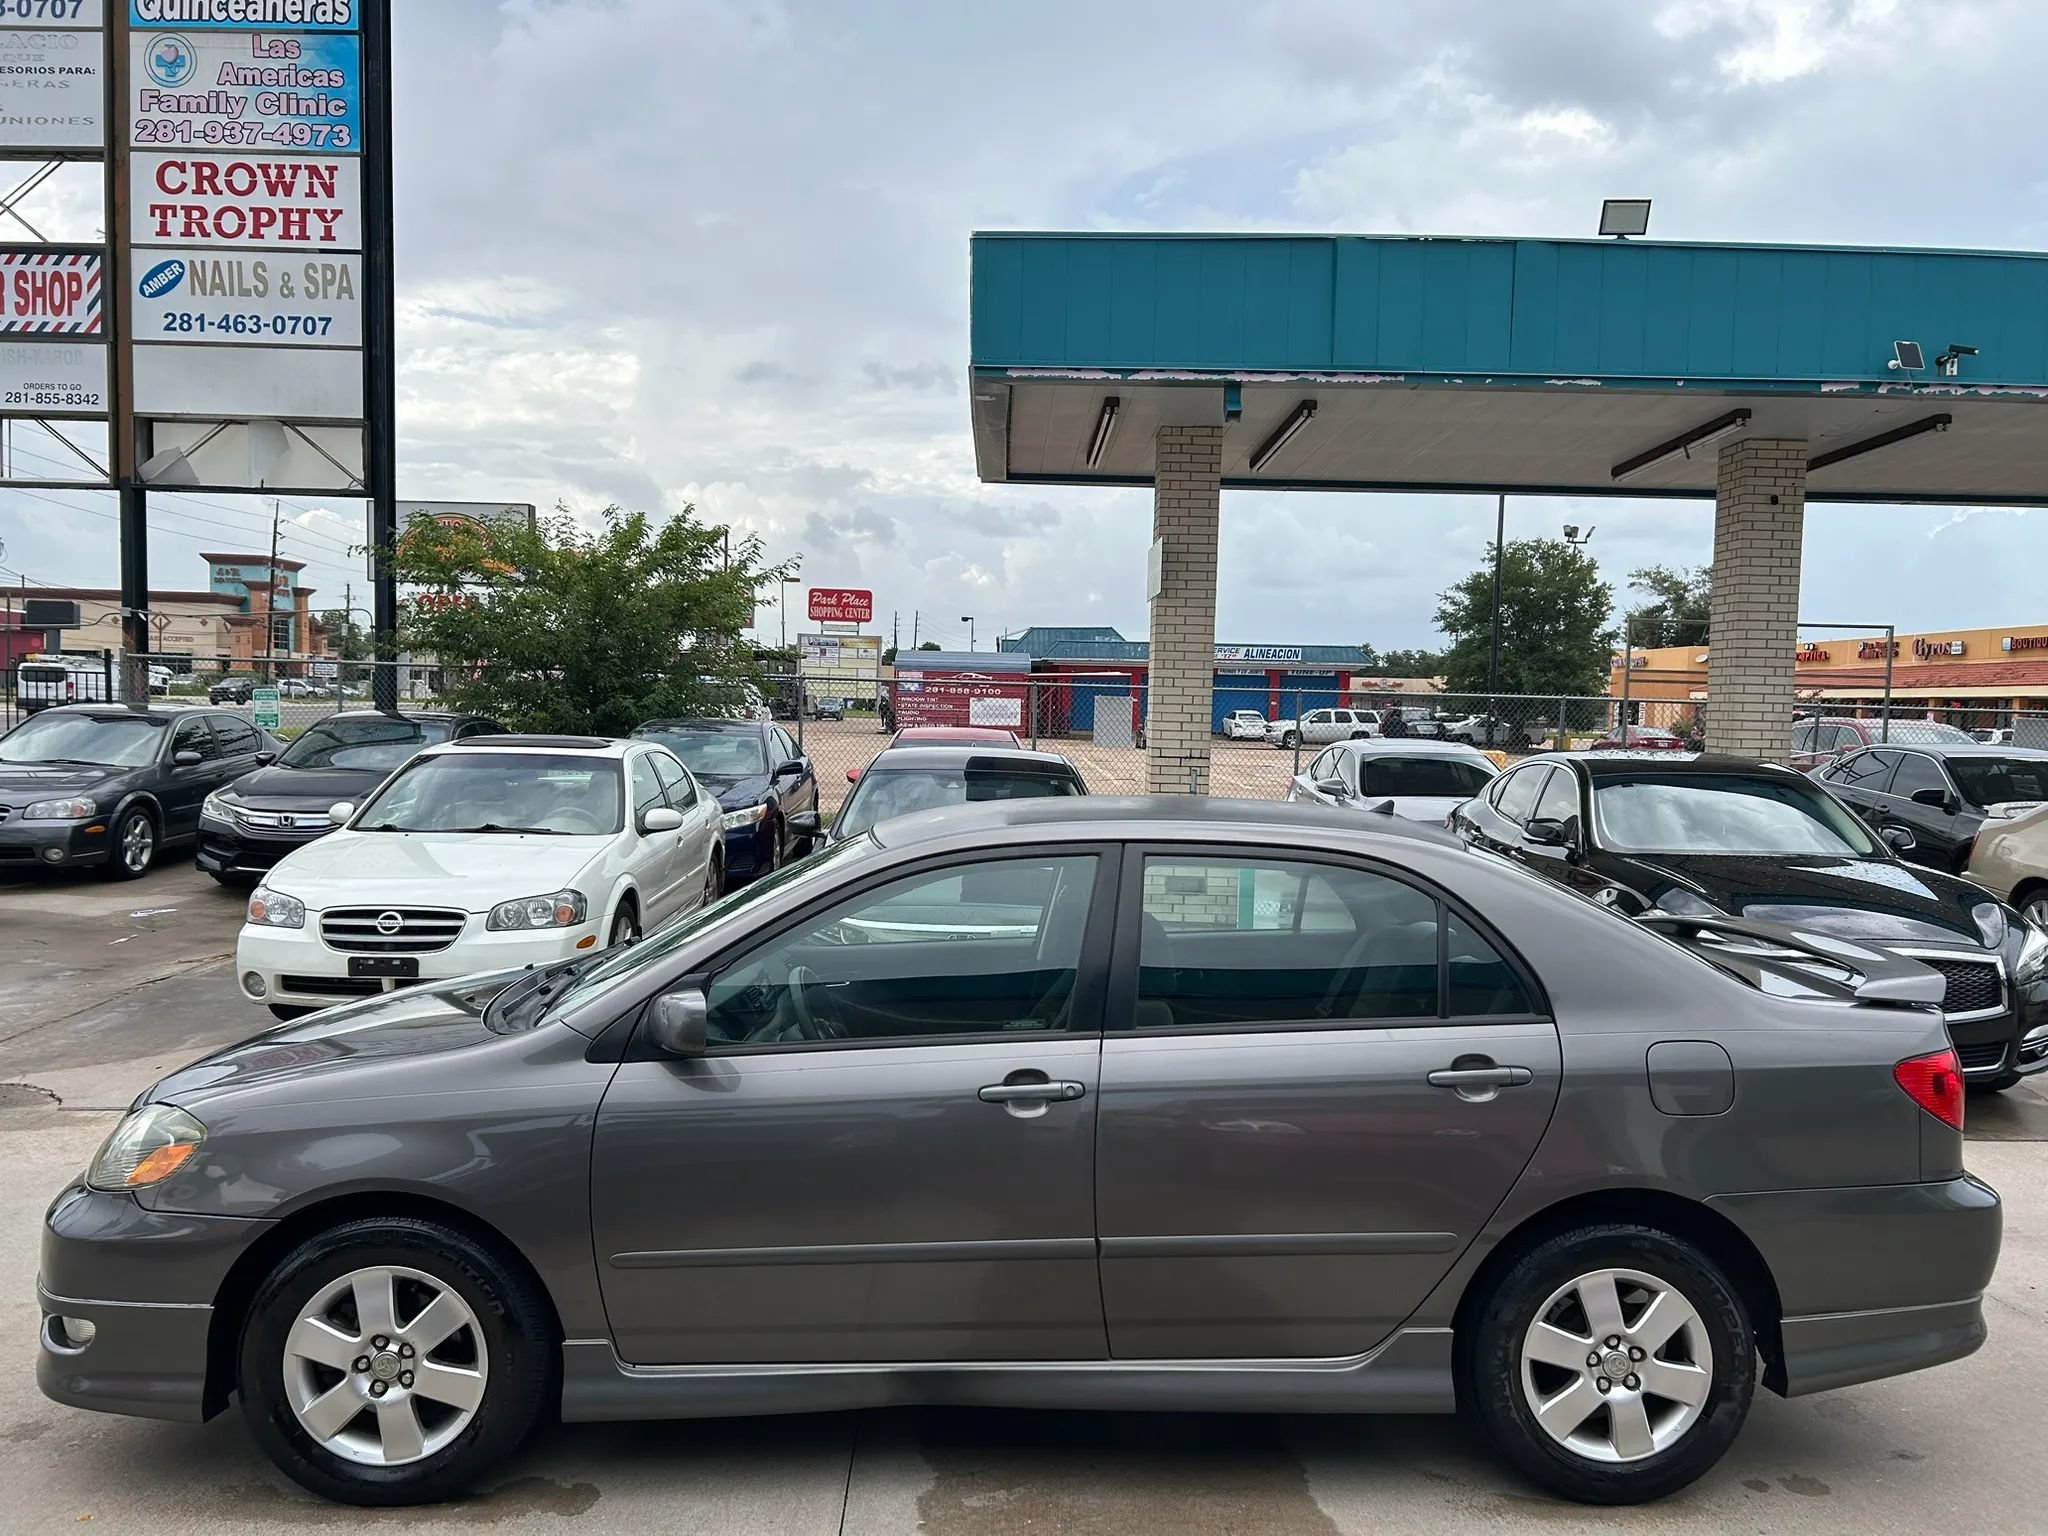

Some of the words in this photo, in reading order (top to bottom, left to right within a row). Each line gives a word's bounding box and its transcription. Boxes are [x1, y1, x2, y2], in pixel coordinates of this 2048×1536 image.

[252, 34, 301, 59] Las
[58, 66, 96, 75] PARA:
[217, 62, 345, 87] Americas
[140, 89, 247, 119] Family
[255, 92, 347, 117] Clinic
[135, 119, 351, 147] 281-937-4973
[156, 160, 338, 198] CROWN
[150, 204, 343, 241] TROPHY
[142, 262, 184, 297] AMBER
[188, 260, 269, 298] NAILS
[279, 272, 295, 298] &
[304, 263, 355, 300] SPA
[14, 270, 82, 317] SHOP
[163, 312, 333, 336] 281-463-0707
[5, 392, 99, 405] 281-855-8342
[23, 382, 55, 390] ORDERS
[69, 383, 82, 391] GO
[812, 592, 838, 605] Park
[841, 593, 869, 606] Place
[810, 606, 843, 618] SHOPPING
[845, 607, 870, 619] CENTER
[1243, 648, 1300, 659] ALINEACION
[1912, 638, 1951, 660] Gyros
